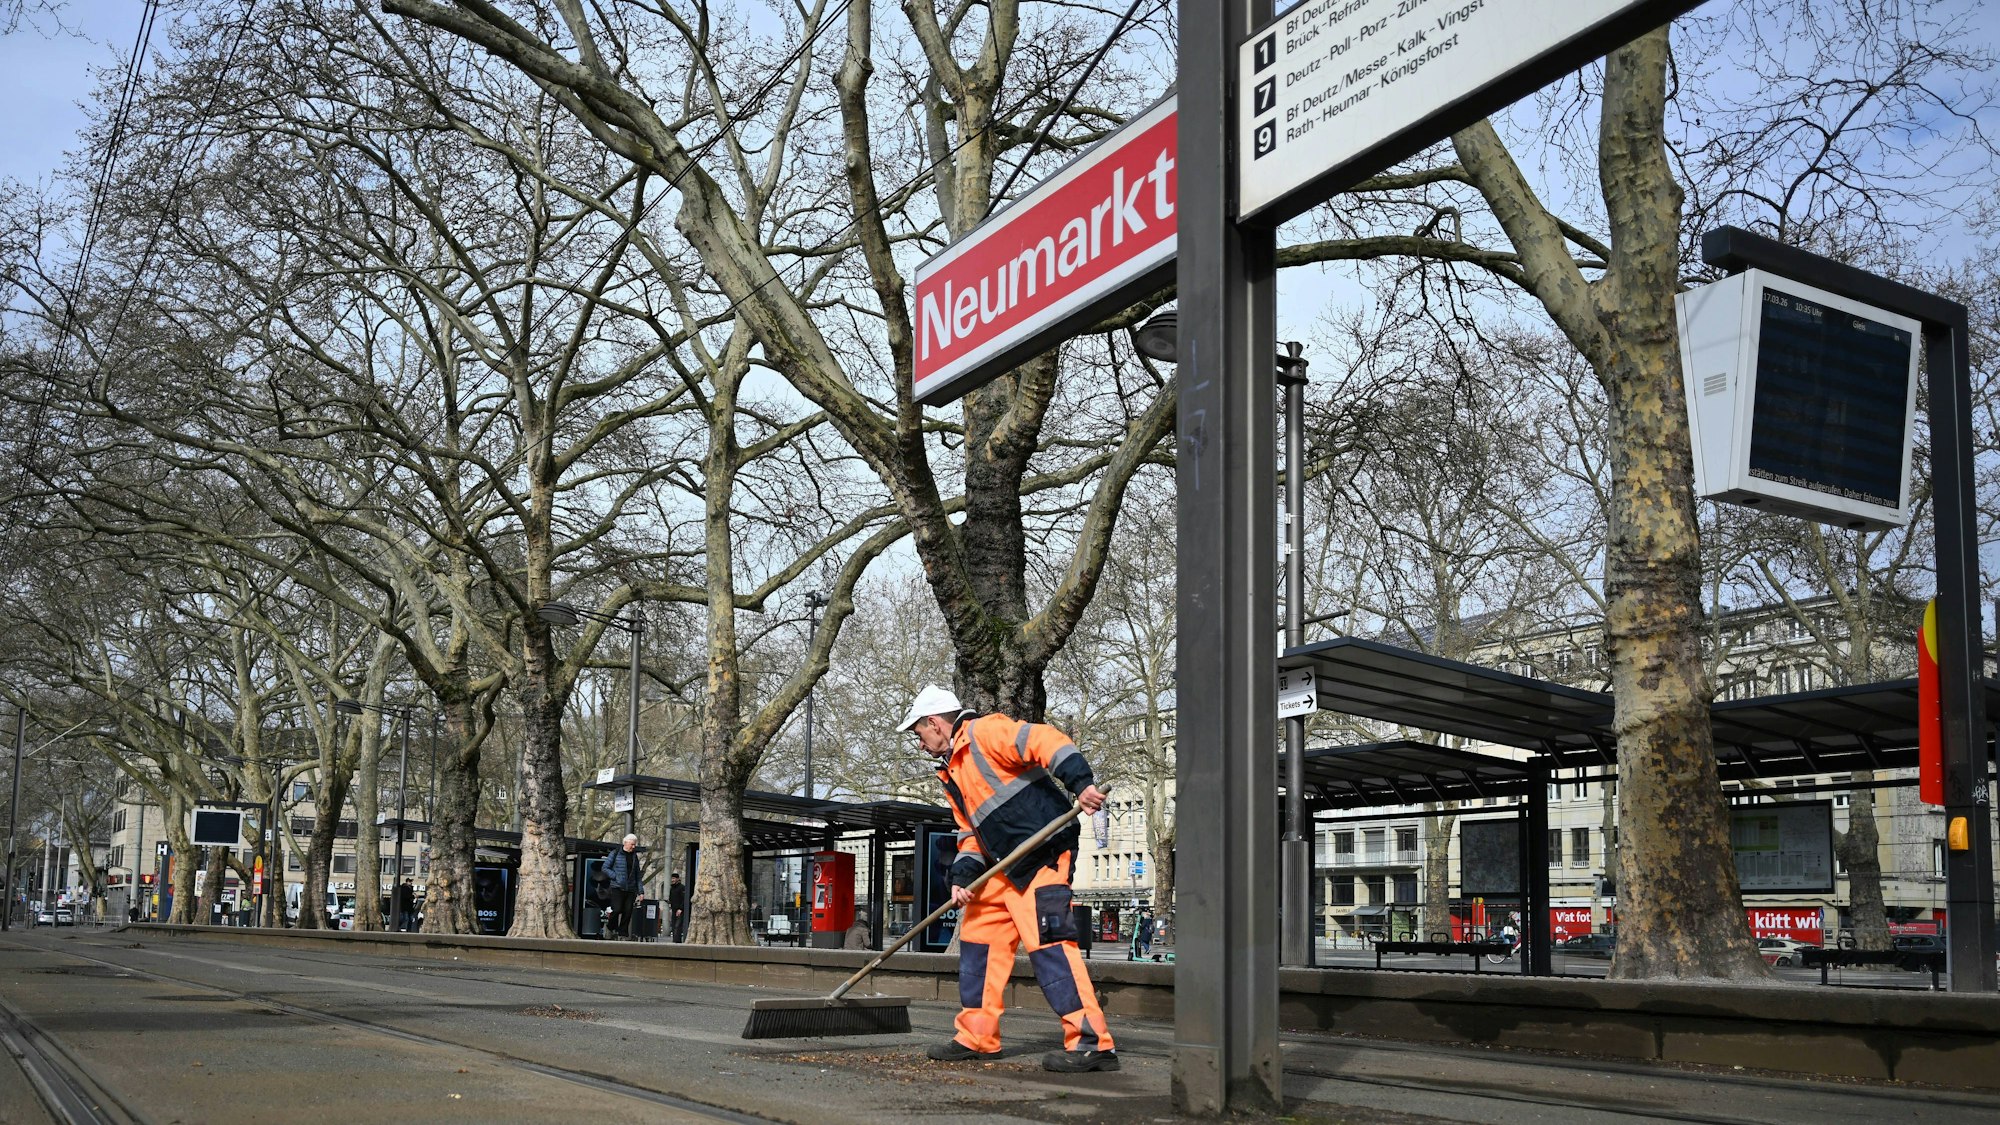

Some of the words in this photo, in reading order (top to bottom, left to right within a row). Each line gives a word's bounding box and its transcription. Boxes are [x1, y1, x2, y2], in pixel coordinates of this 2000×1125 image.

[1286, 16, 1299, 36] Bf
[1258, 82, 1271, 110] 7
[1287, 103, 1300, 123] Bf
[1258, 126, 1272, 153] 9
[921, 147, 1175, 362] Neumarkt
[1763, 292, 1788, 307] 17.03.26
[1795, 302, 1811, 314] 10:35
[1812, 307, 1823, 317] Uhr
[1775, 474, 1789, 484] zum
[1789, 475, 1808, 489] Streik
[1844, 488, 1862, 500] Daher
[1280, 702, 1301, 711] Tickets
[158, 844, 168, 856] H
[1755, 911, 1791, 929] kütt
